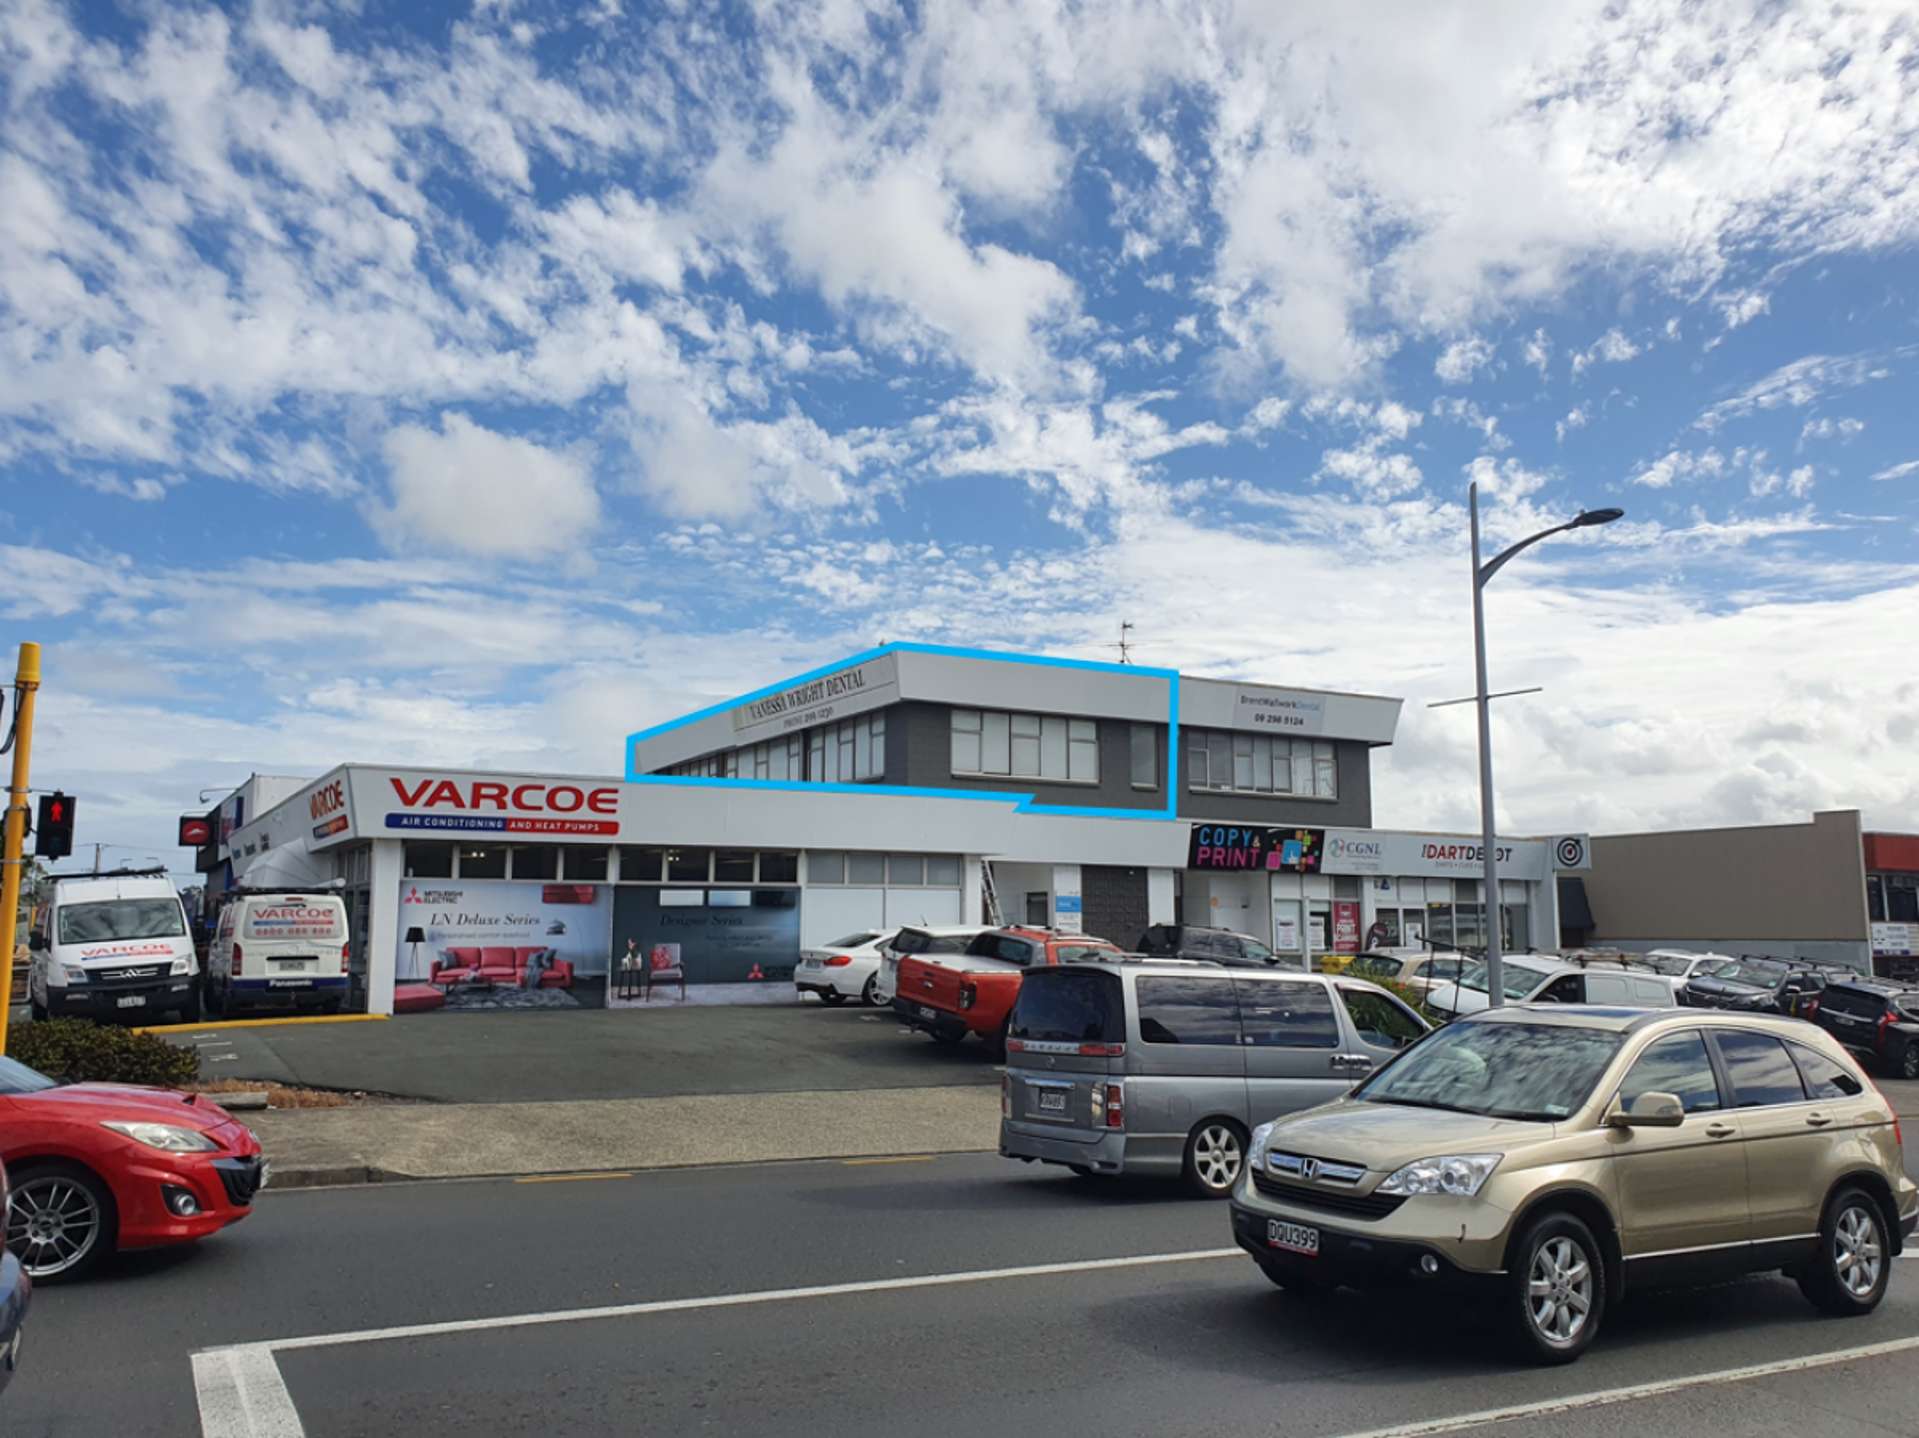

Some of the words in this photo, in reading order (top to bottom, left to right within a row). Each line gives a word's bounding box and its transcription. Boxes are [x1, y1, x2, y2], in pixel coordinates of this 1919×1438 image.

[787, 682, 825, 707] WRIGHT
[826, 669, 865, 696] DENTAL
[390, 778, 619, 814] VARCOE
[401, 817, 421, 826] AIR
[424, 818, 503, 829] CONDITIONING
[510, 820, 531, 830] AND
[535, 821, 561, 831] HEAT
[564, 823, 600, 832] PUMPS
[1199, 827, 1253, 847] COPY
[1197, 846, 1262, 867] PRINT
[1427, 844, 1513, 862] DARTDEOT
[430, 913, 453, 926] LN
[456, 913, 501, 926] Deluxe
[503, 913, 541, 926] Series
